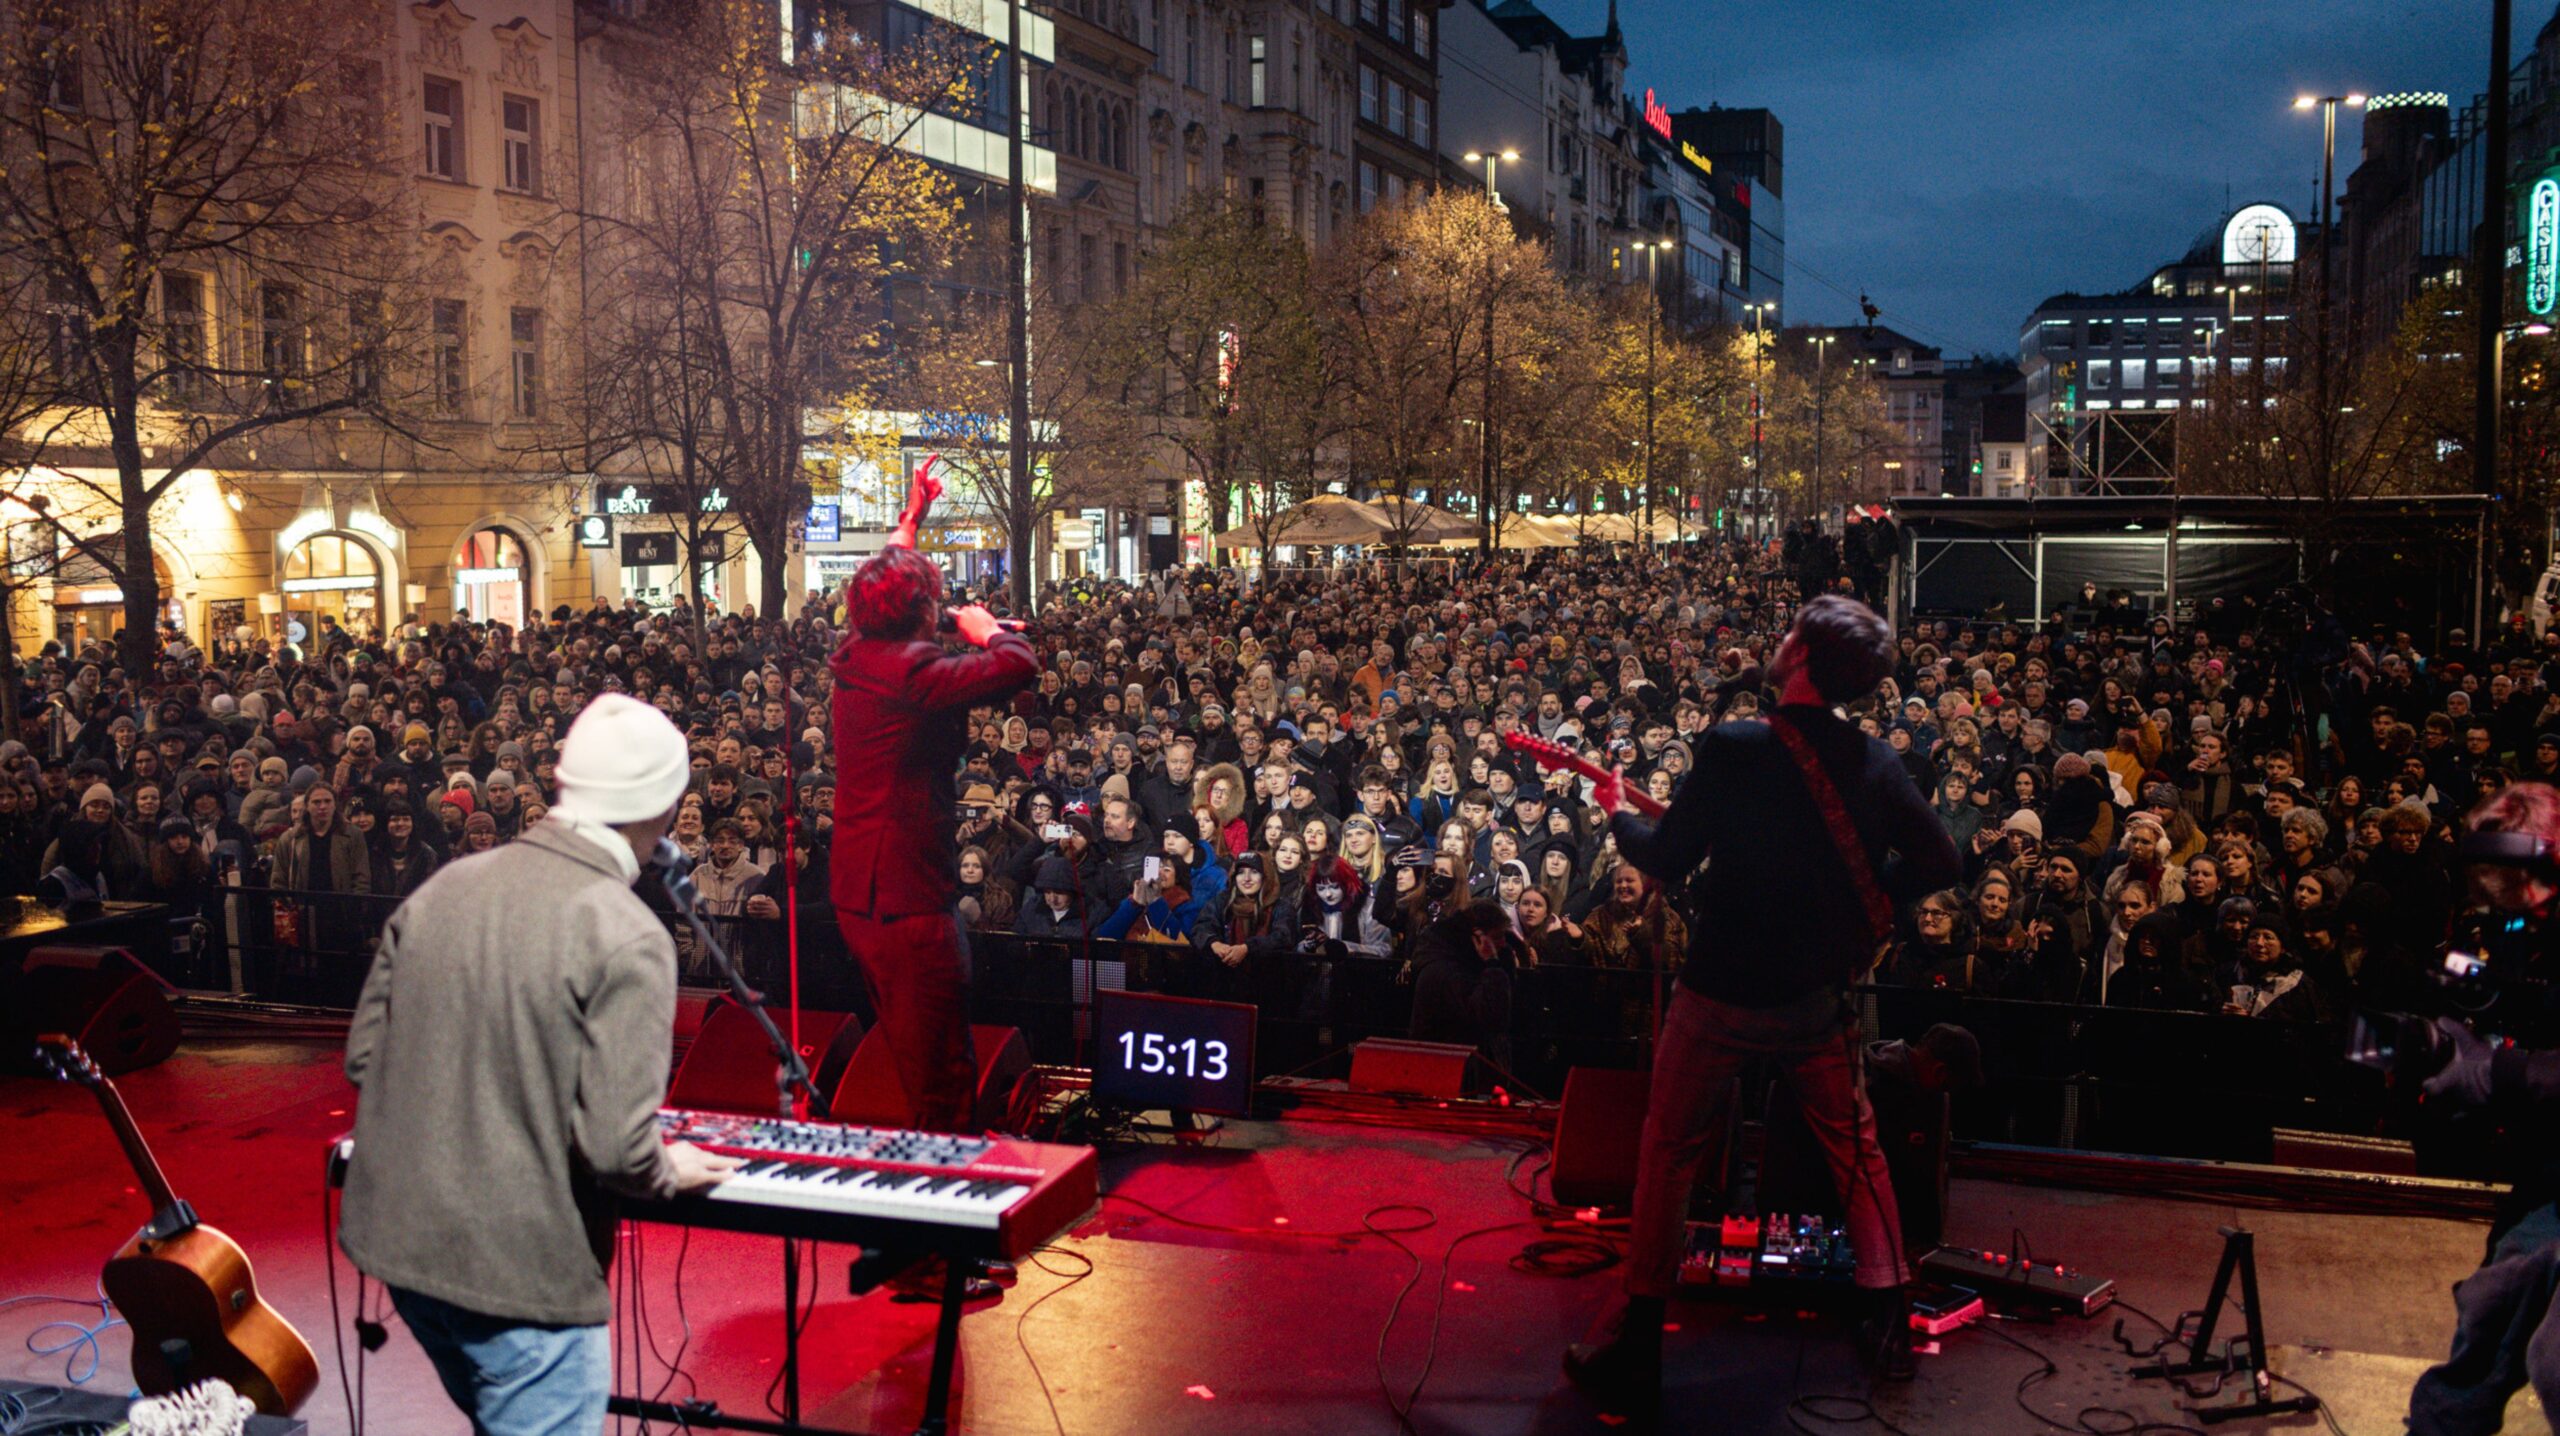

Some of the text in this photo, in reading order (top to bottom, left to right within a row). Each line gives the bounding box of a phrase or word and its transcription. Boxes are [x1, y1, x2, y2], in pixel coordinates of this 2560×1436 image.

[2535, 189, 2554, 303] CASINO
[607, 498, 652, 514] BENY
[638, 547, 657, 560] BENY
[1118, 1031, 1228, 1080] 15:13
